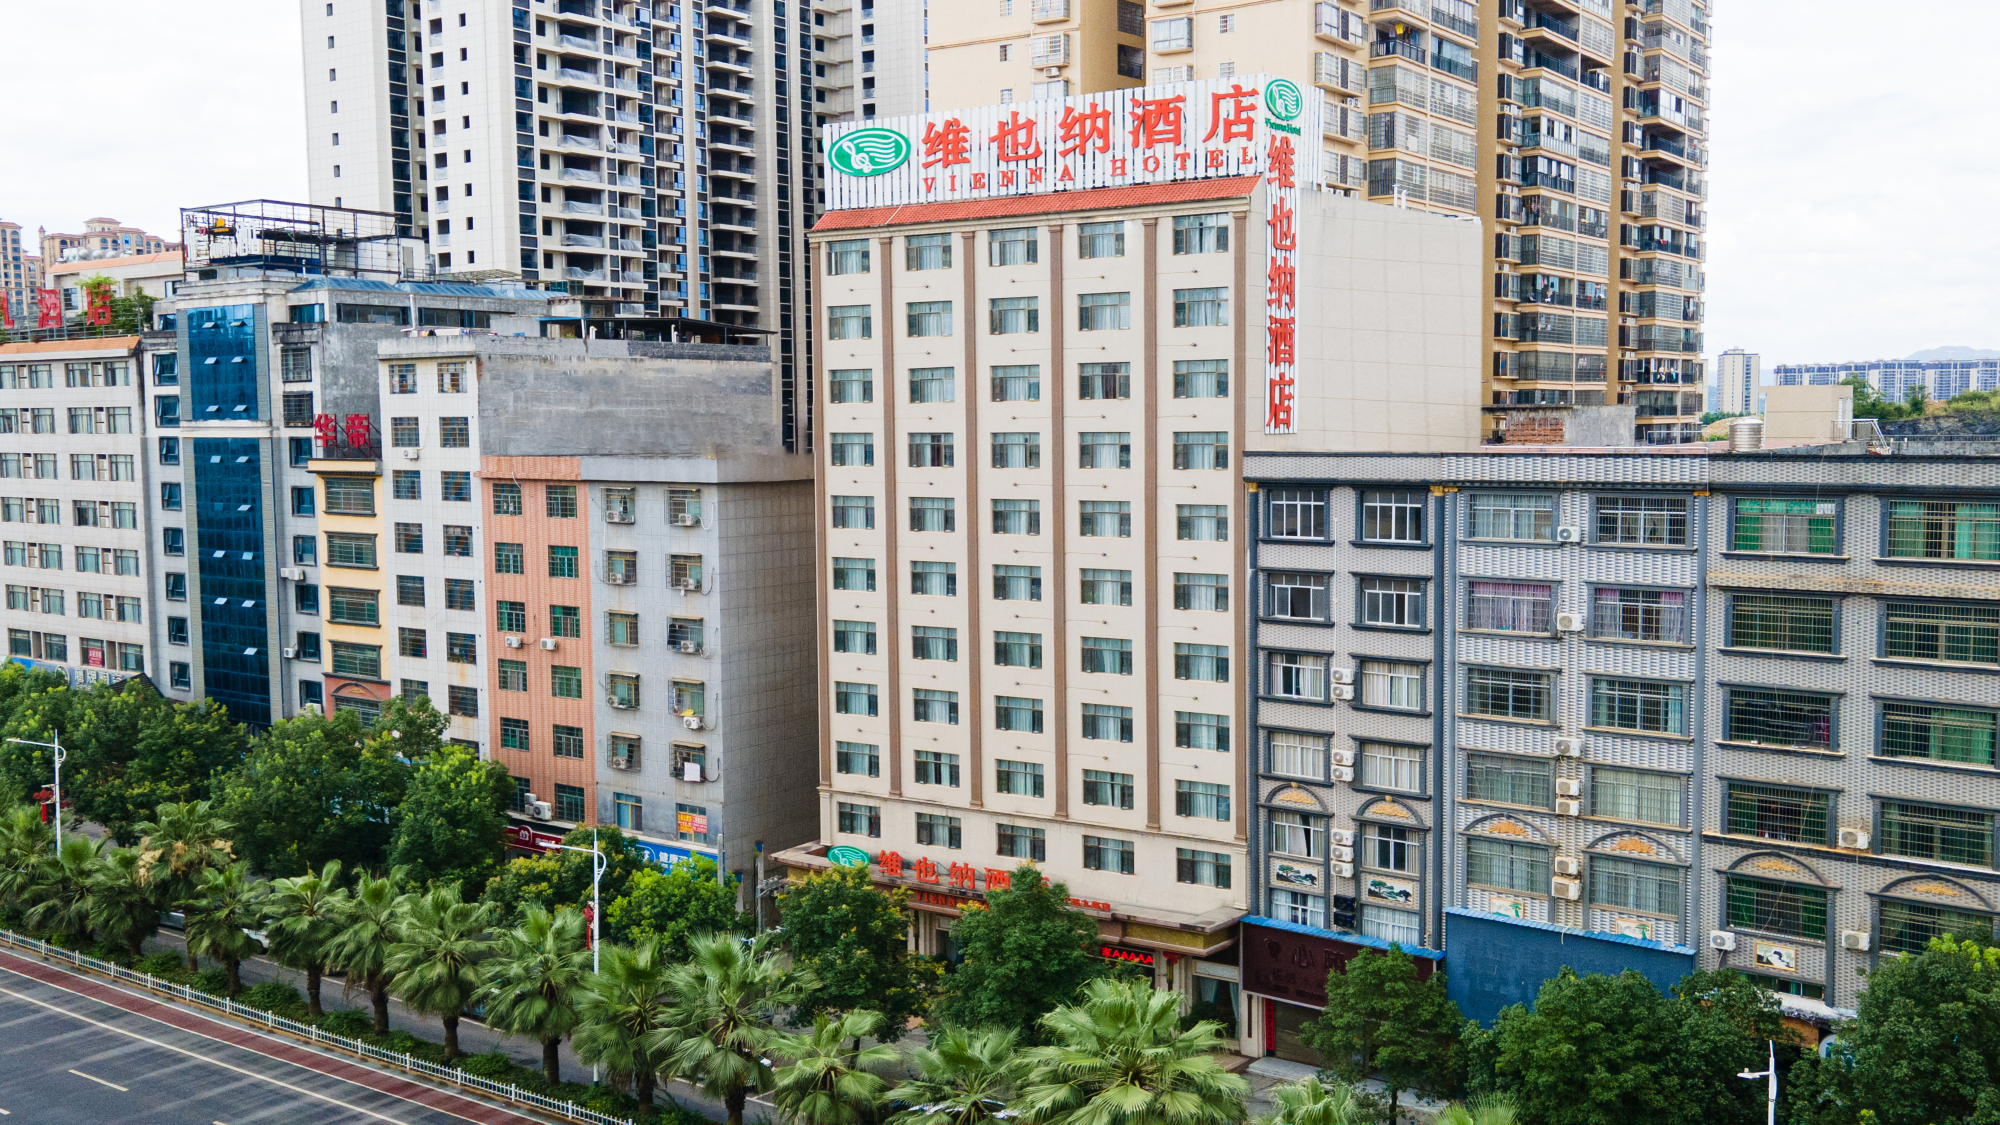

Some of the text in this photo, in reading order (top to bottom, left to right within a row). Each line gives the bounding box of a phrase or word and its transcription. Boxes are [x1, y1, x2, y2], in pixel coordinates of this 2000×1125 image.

[922, 84, 1259, 169] 维也纳酒店
[923, 147, 1254, 193] VIENNA HOTEL
[1266, 134, 1297, 430] 维也纳酒店
[313, 413, 370, 448] 华帝
[877, 849, 1051, 892] 维也纳酒
